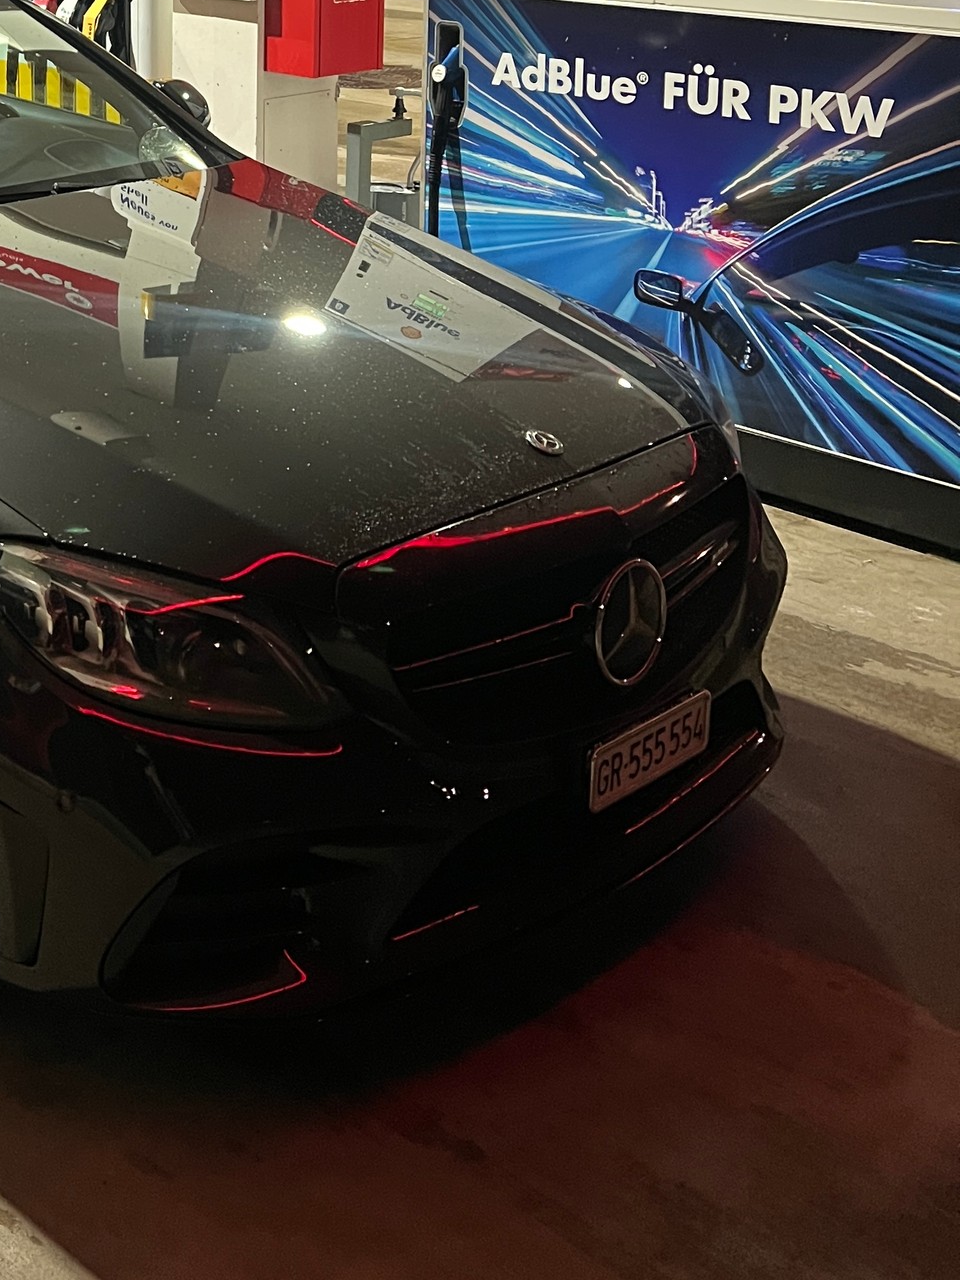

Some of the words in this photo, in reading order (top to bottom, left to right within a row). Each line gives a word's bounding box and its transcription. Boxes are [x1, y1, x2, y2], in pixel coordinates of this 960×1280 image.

[663, 64, 752, 121] FÜR
[768, 85, 895, 138] PKW
[669, 706, 704, 756] 554
